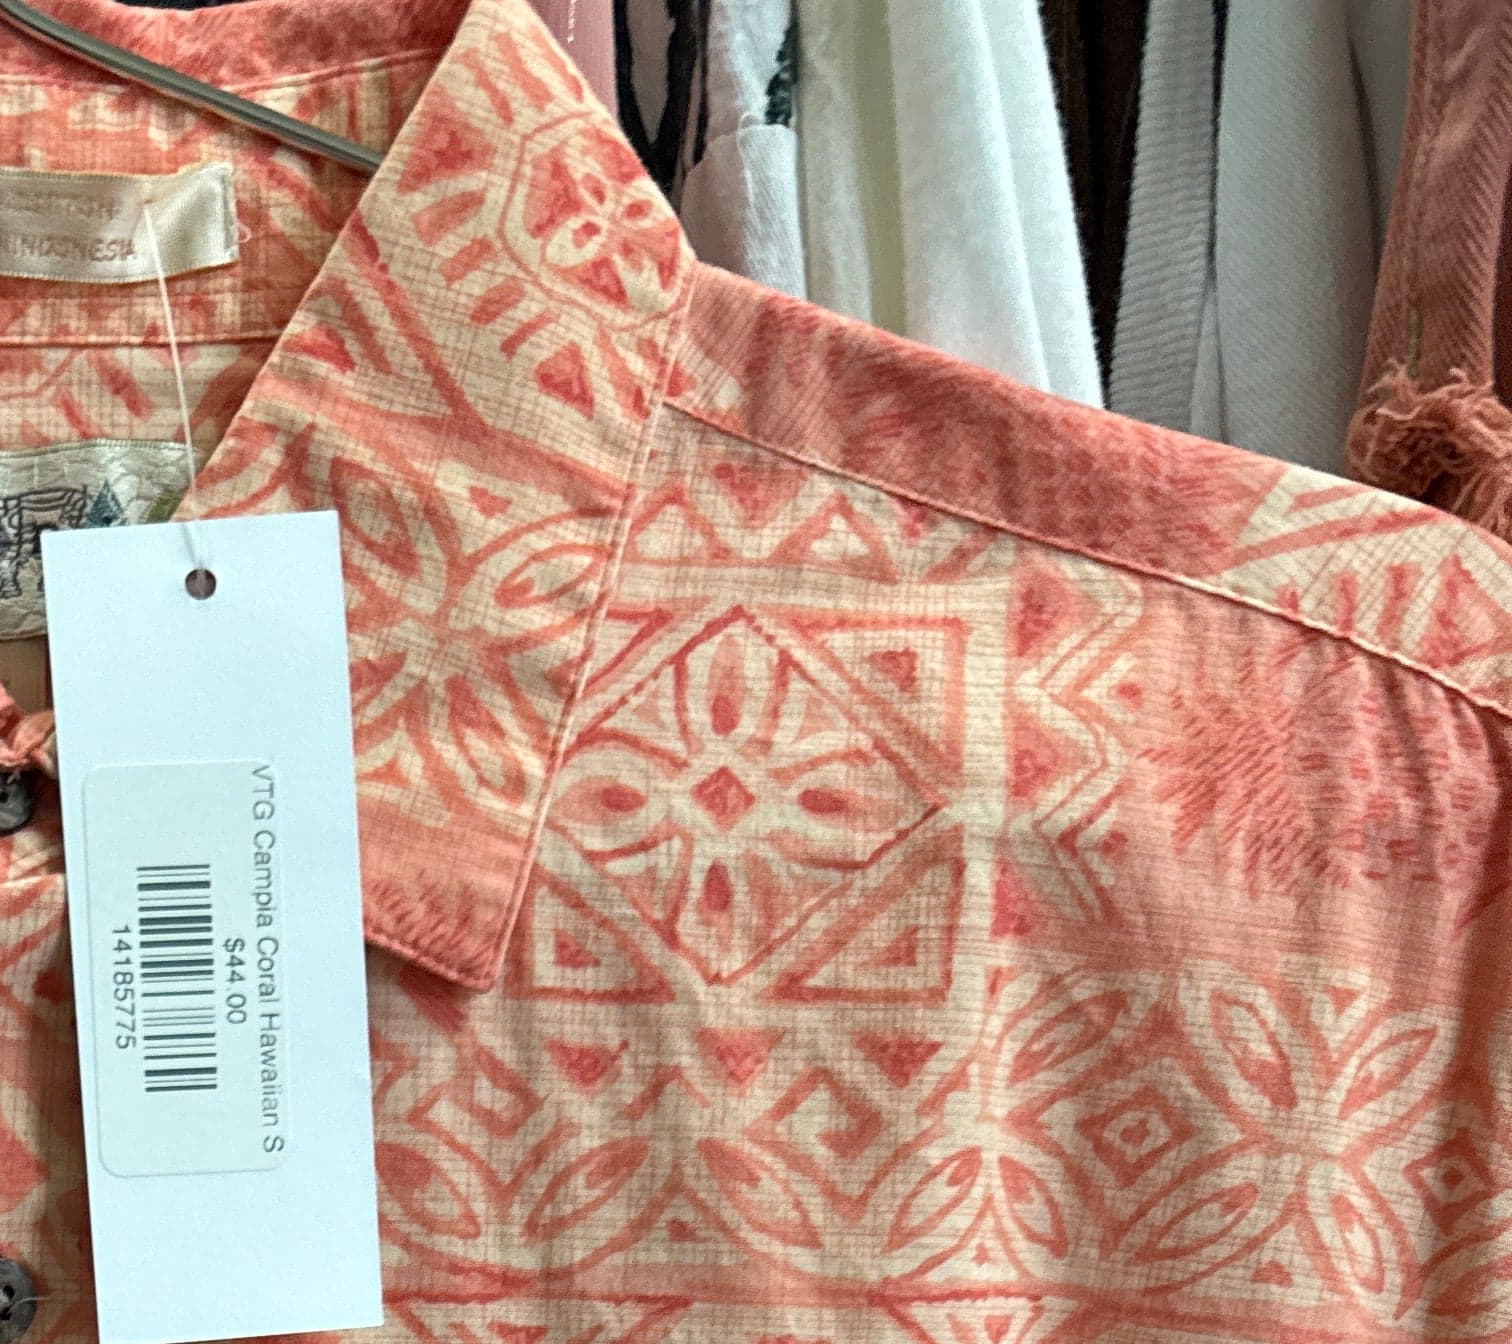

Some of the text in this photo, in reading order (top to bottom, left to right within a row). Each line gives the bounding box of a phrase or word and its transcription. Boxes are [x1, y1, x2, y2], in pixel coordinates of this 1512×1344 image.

[111, 924, 137, 1050] 14185775
[221, 937, 248, 1025] $44.00
[251, 765, 286, 1153] VTG Campia Coral Hawaiian S
